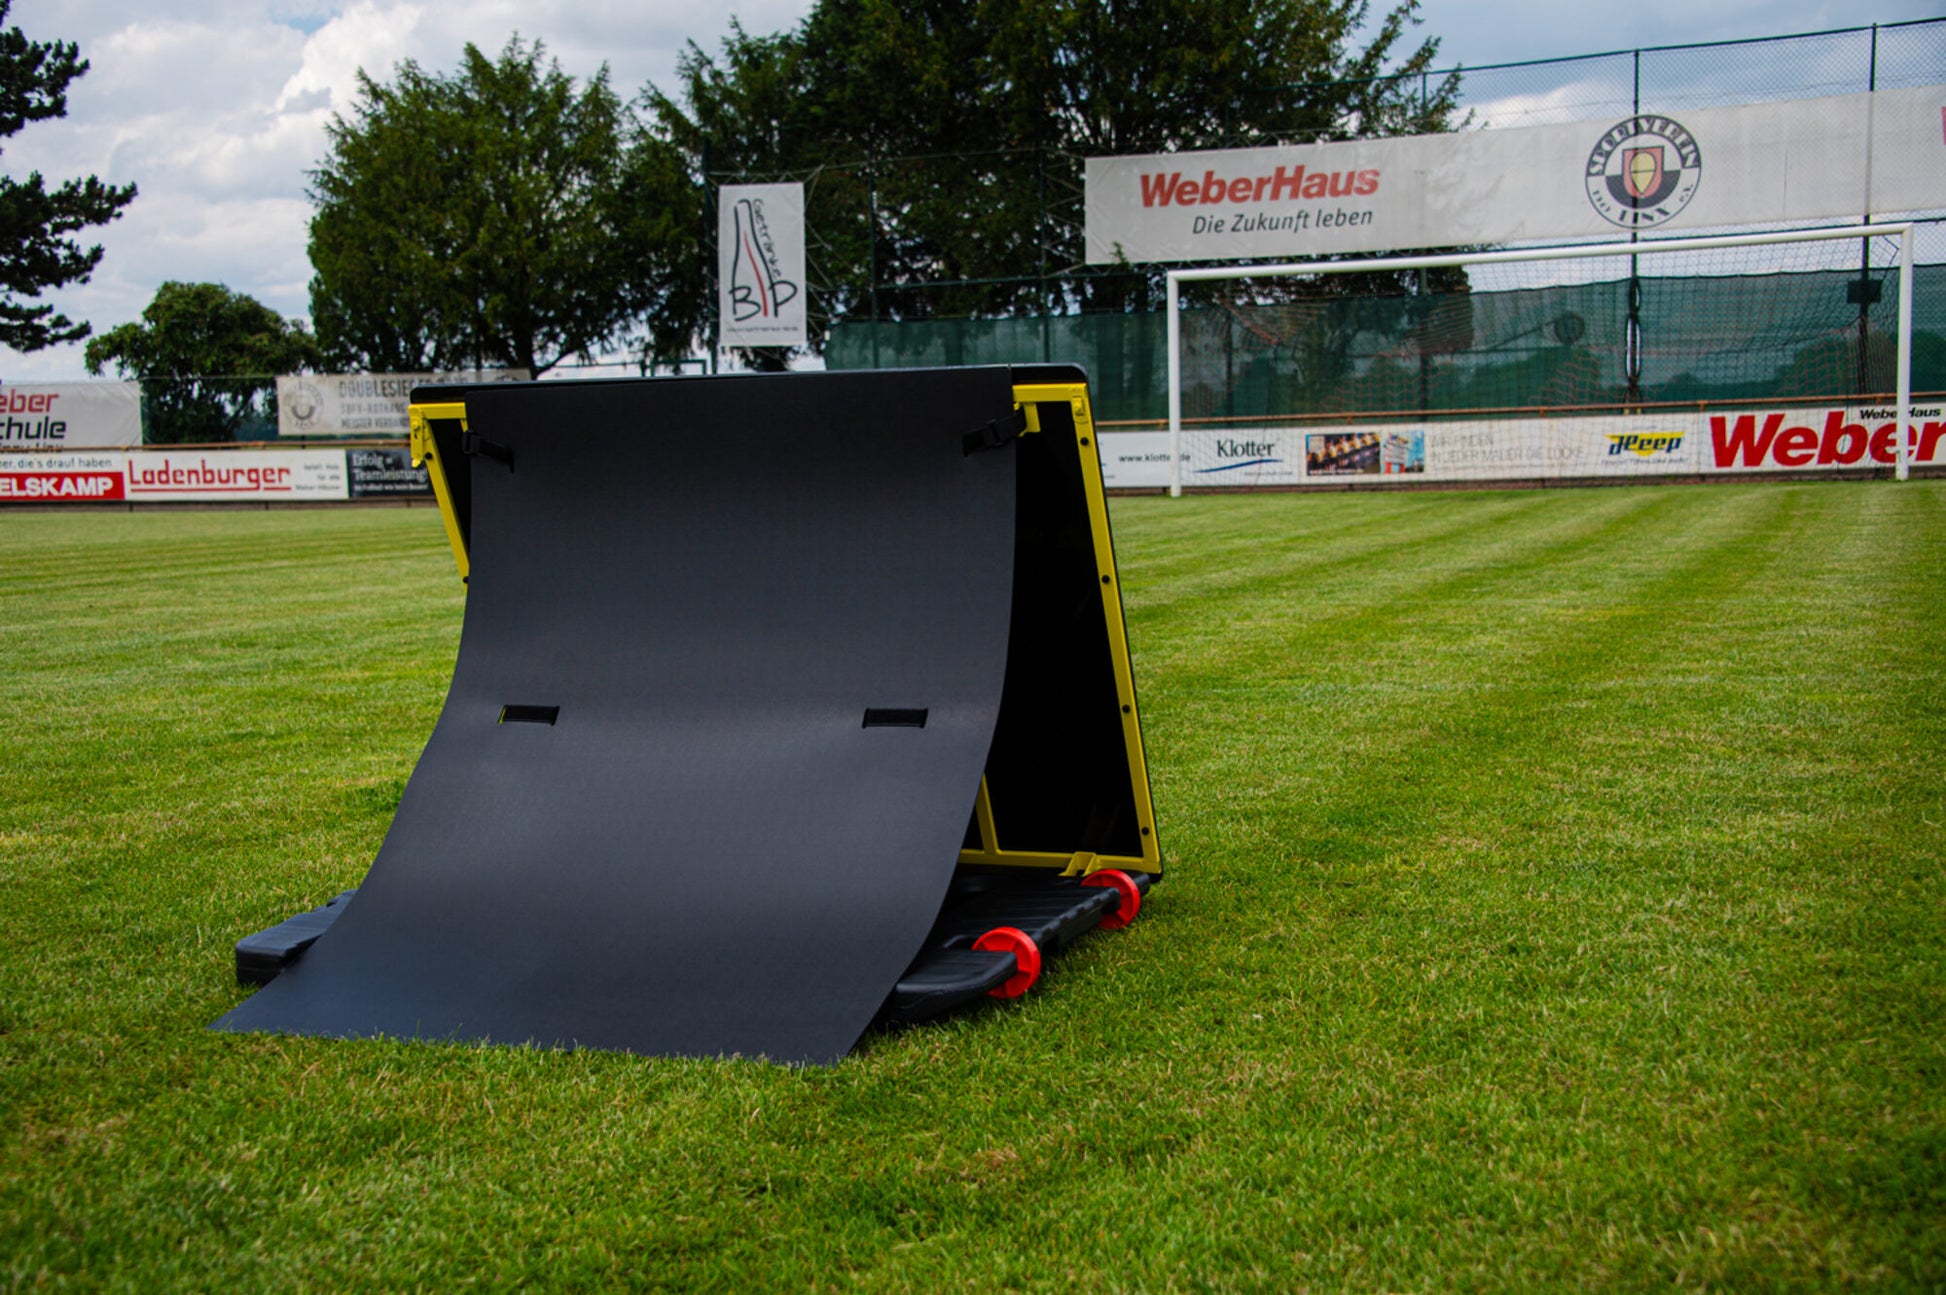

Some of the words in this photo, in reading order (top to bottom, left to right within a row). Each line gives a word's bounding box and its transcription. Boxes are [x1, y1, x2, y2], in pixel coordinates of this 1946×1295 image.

[1140, 164, 1380, 208] WeberHaus
[1192, 215, 1225, 234] Die
[1231, 209, 1309, 233] Zukunft
[1315, 208, 1374, 226] leben
[1216, 440, 1275, 457] Klotter
[1710, 410, 1946, 468] Weber
[46, 457, 75, 468] drauf
[79, 457, 112, 468] haben
[128, 459, 291, 489] Ladenburger
